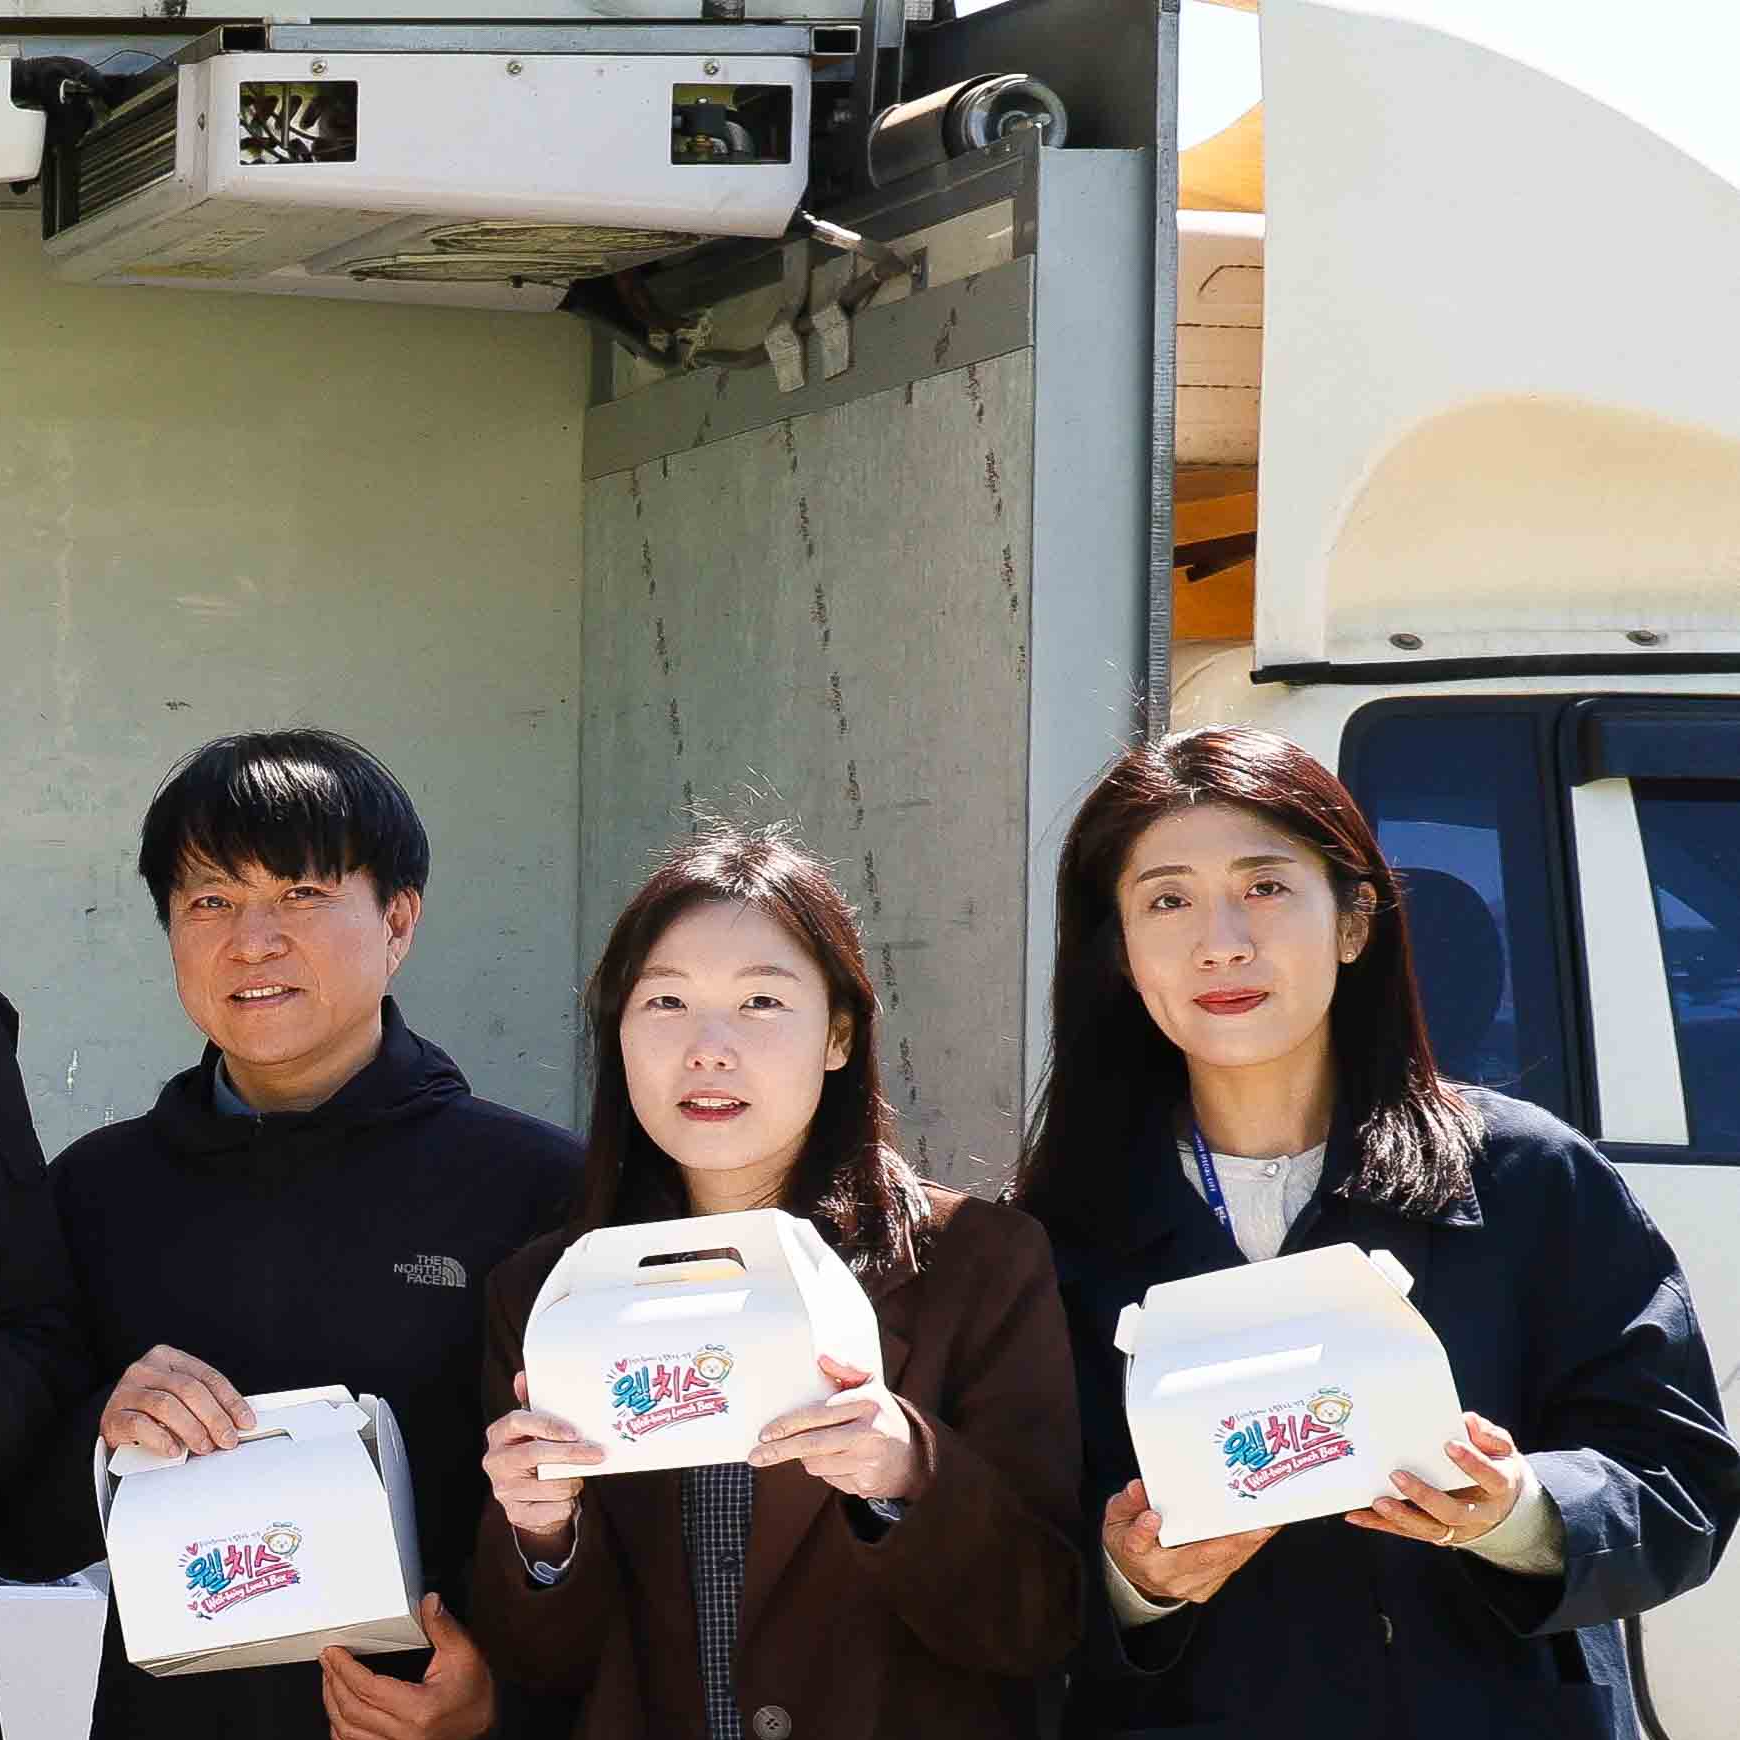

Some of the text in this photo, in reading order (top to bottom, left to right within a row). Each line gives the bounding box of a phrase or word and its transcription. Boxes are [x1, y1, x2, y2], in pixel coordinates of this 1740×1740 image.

[417, 1255, 441, 1265] THE
[393, 1263, 441, 1275] NORTH
[407, 1273, 441, 1285] FACE
[612, 1364, 722, 1415] 웰치스
[1224, 1414, 1345, 1472] 웰치스
[1320, 1446, 1340, 1459] Box
[185, 1544, 292, 1595] 웰치스
